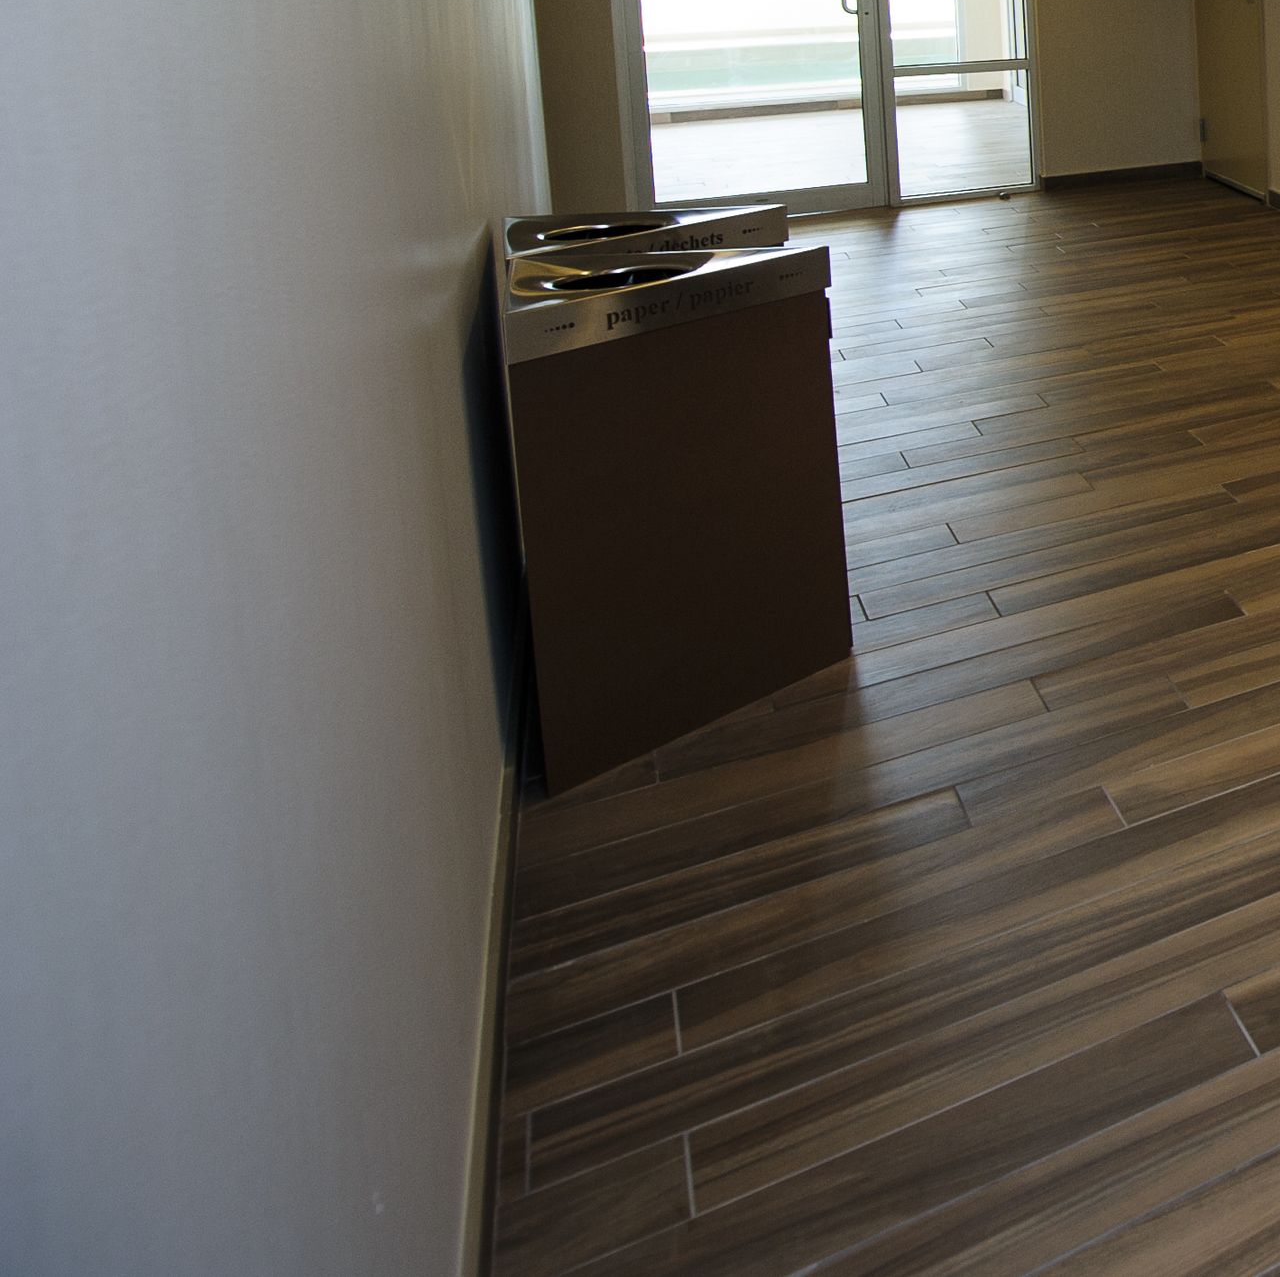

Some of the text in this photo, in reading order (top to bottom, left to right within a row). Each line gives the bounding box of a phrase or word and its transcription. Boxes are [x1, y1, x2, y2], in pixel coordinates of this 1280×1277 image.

[660, 233, 723, 252] déchets
[606, 299, 669, 330] paper
[690, 281, 754, 310] papier
